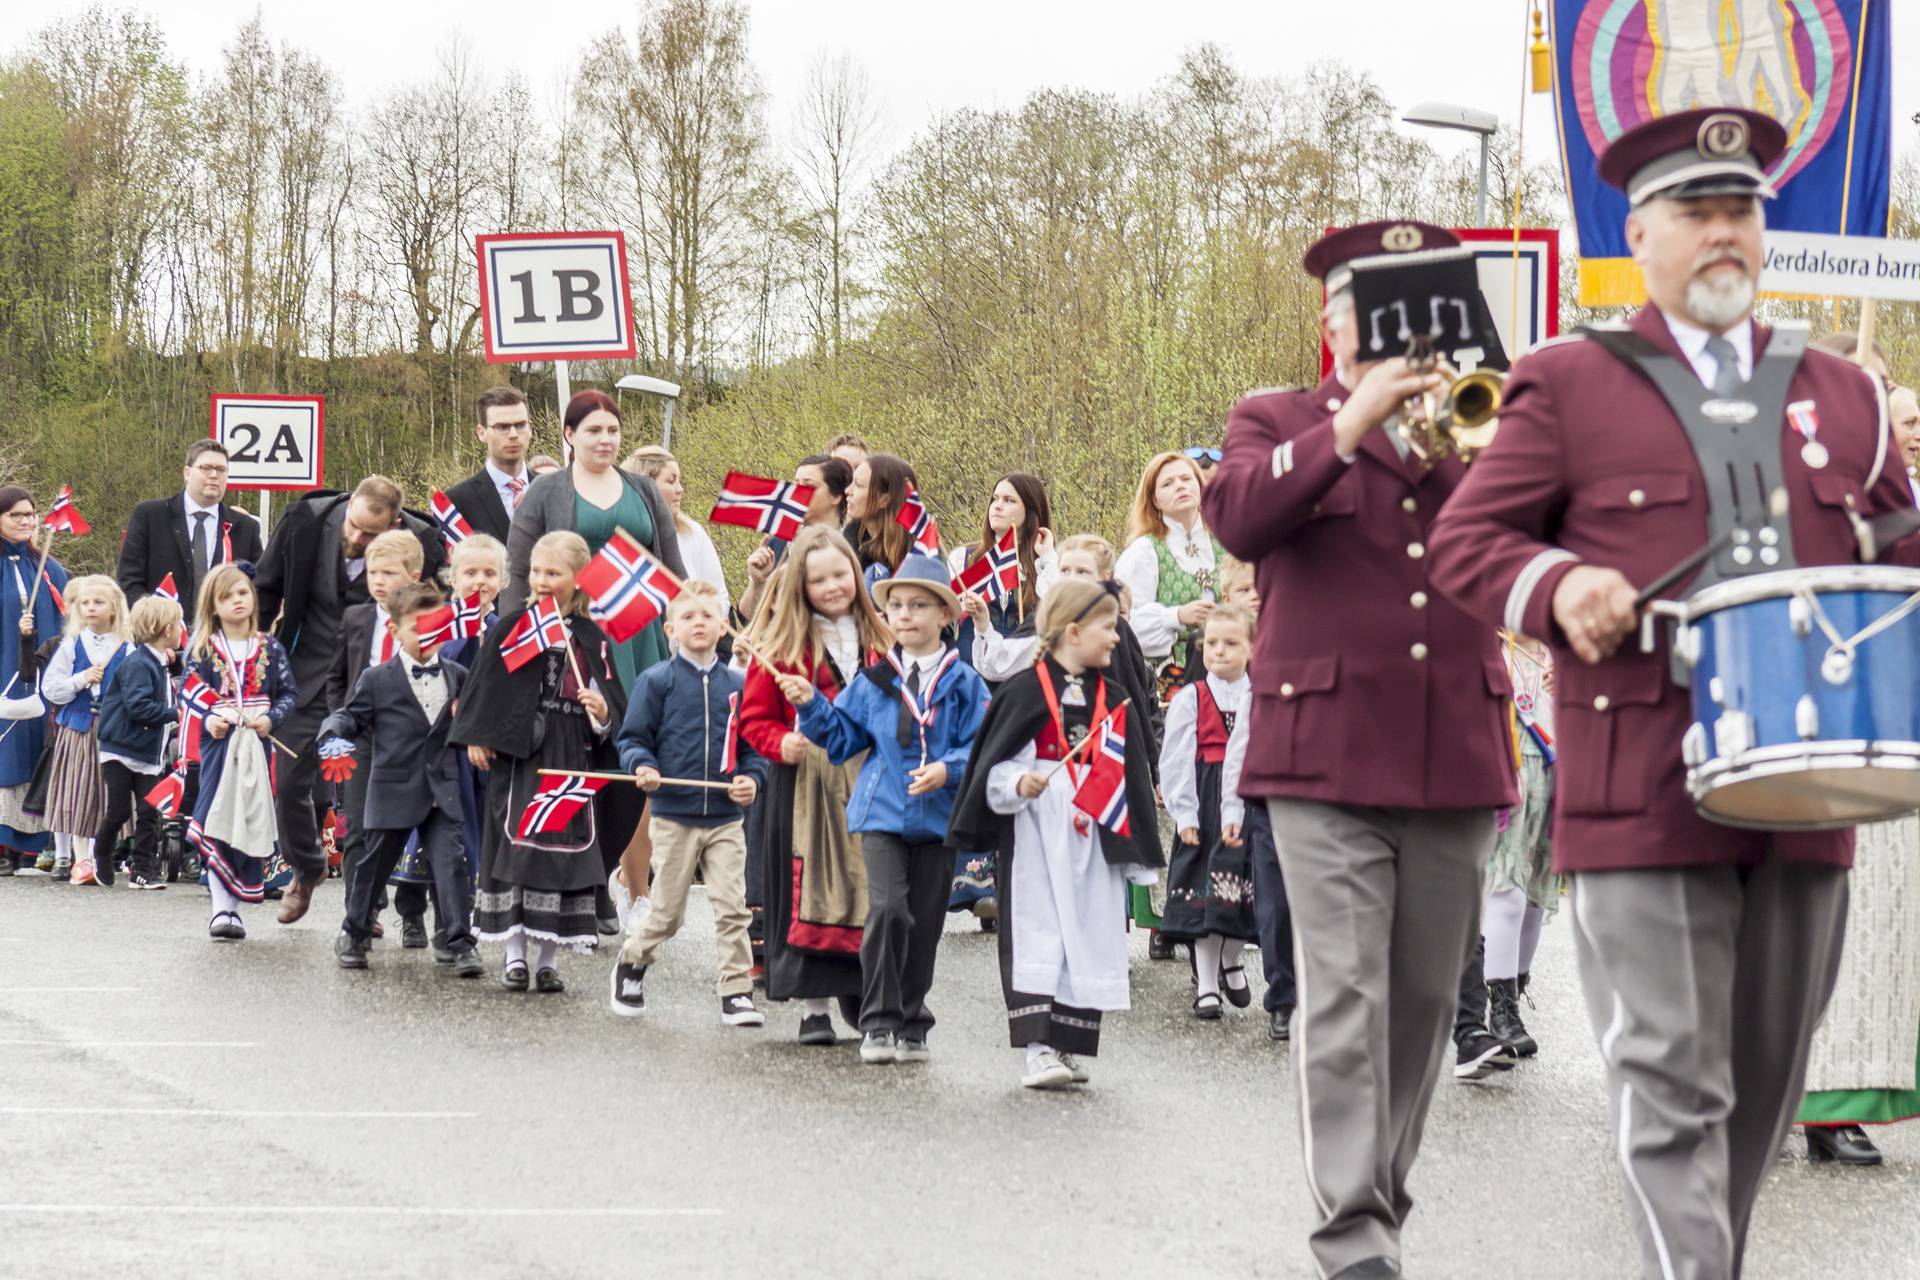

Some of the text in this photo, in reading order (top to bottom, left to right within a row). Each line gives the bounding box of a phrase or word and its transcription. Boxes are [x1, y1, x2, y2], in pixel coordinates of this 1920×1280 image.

[1763, 247, 1869, 276] Verdalsøra
[510, 269, 604, 324] 1B
[229, 423, 303, 463] 2A
